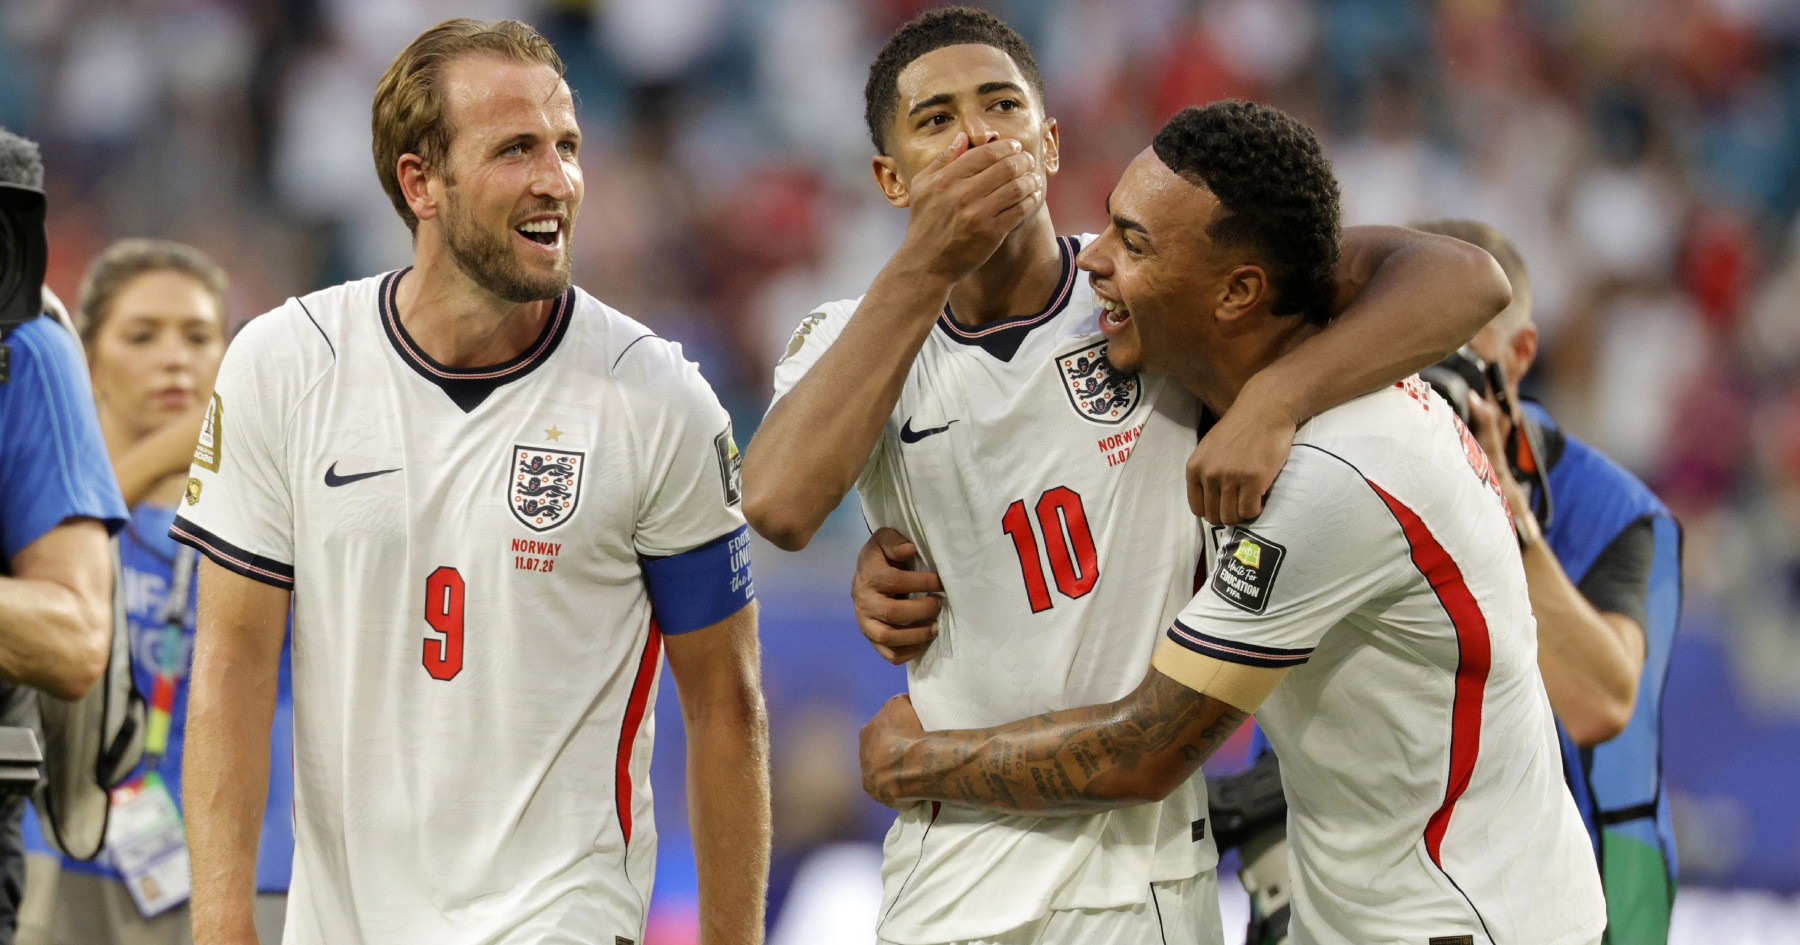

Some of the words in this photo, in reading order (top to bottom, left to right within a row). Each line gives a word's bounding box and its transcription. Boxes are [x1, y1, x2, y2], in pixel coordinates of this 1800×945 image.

[1107, 447, 1130, 467] 11.07
[511, 538, 562, 556] NORWAY
[1001, 485, 1100, 614] 10
[515, 556, 554, 573] 11.07.26
[1227, 558, 1246, 576] Unite
[1244, 568, 1258, 581] For
[1220, 568, 1260, 598] EDUCATION
[1226, 586, 1242, 600] FIFA
[422, 565, 466, 681] 9
